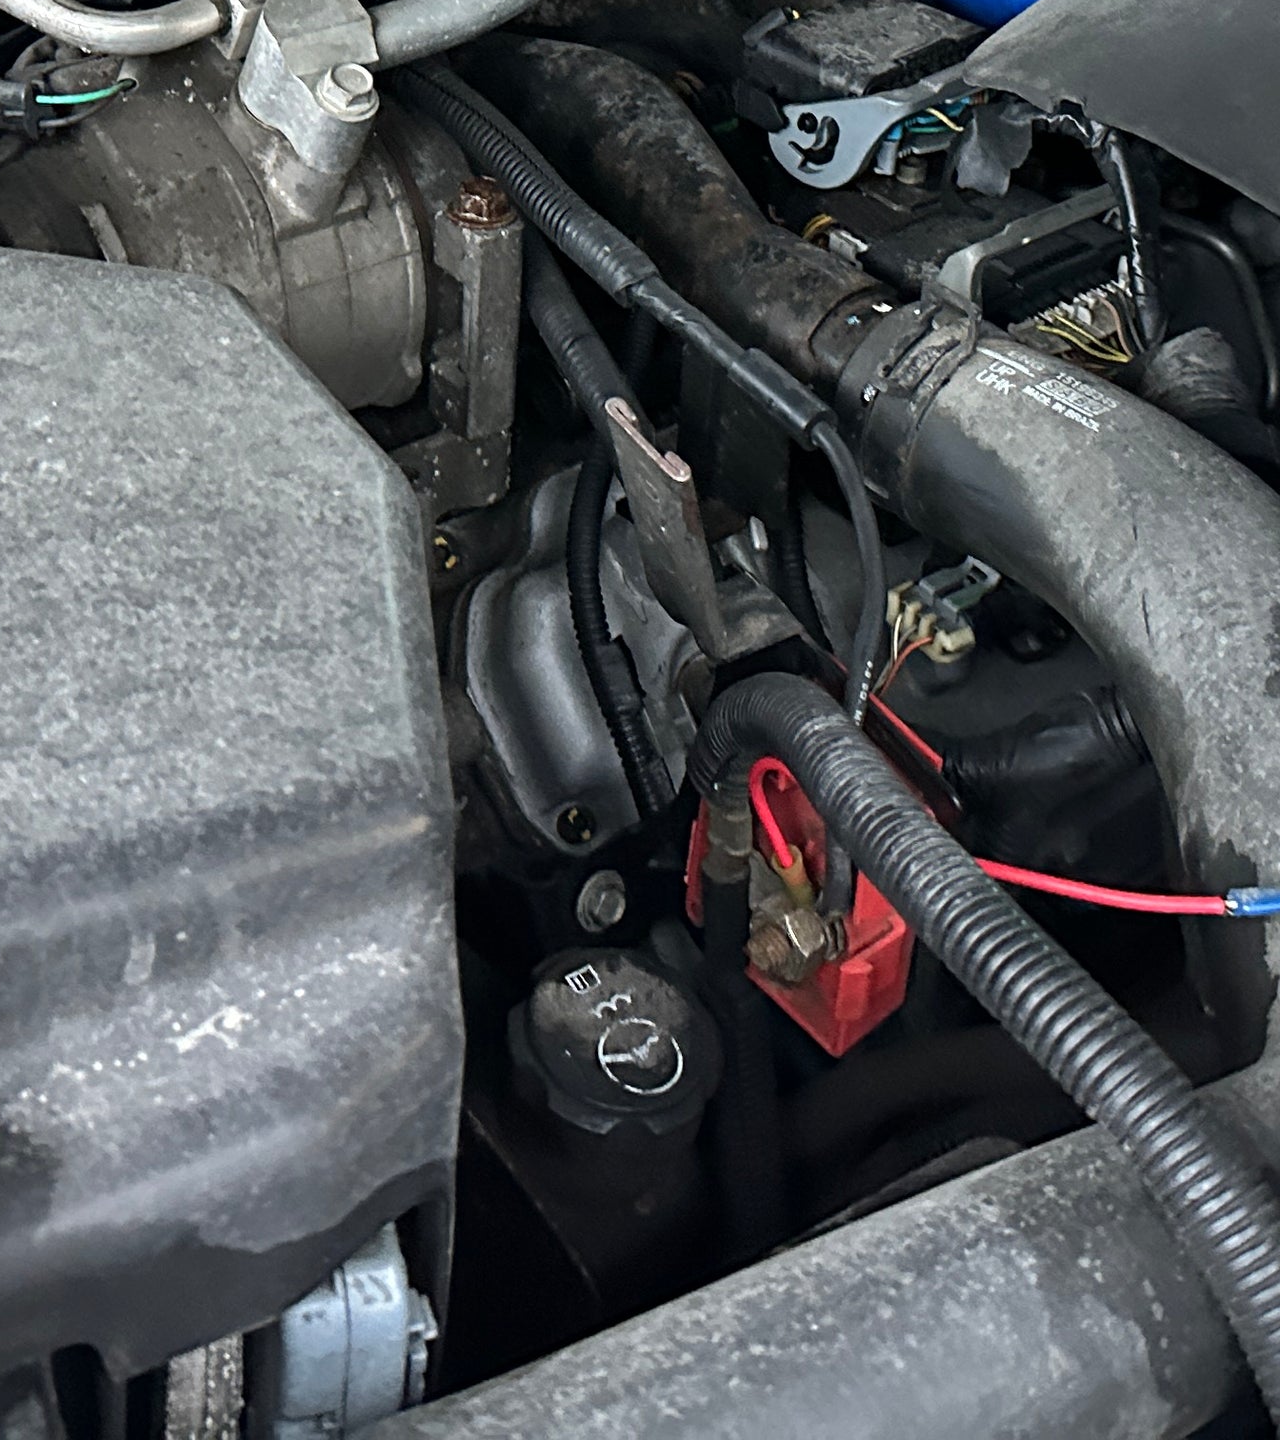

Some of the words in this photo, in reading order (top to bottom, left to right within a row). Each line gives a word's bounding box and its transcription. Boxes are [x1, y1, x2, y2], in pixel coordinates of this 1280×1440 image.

[989, 361, 1016, 376] UP
[1022, 385, 1052, 406] MADE
[1051, 401, 1066, 414] IN
[1064, 409, 1101, 433] BRAZIL
